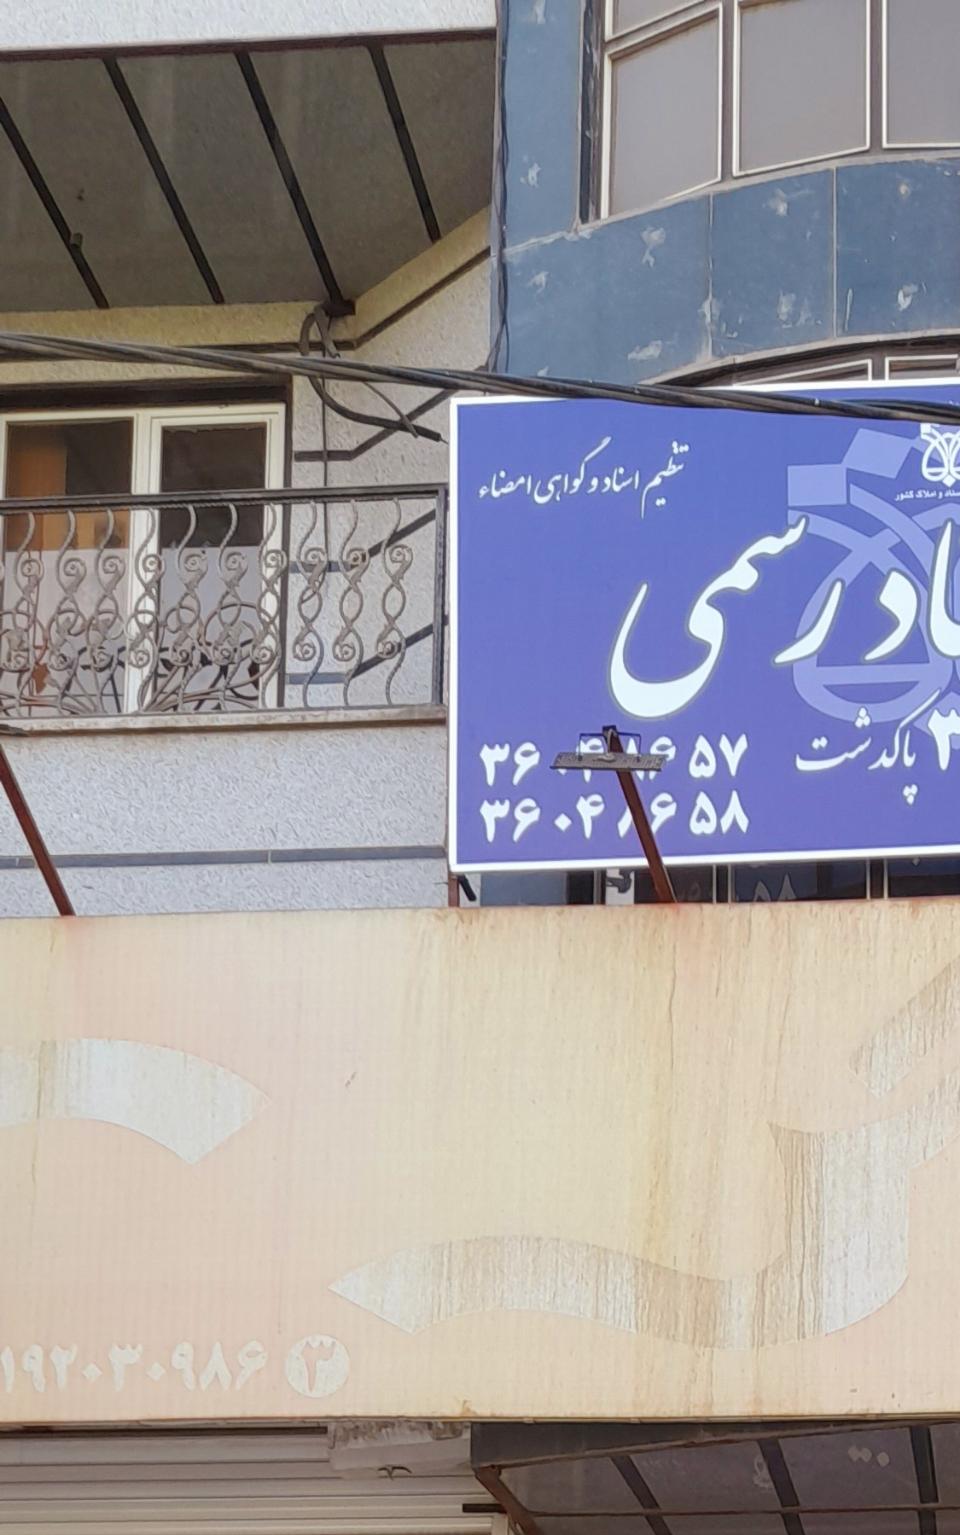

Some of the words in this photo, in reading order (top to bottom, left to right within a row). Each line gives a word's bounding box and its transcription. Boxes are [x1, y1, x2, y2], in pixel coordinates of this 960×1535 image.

[479, 471, 532, 498] امضاء
[587, 476, 599, 494] و
[602, 467, 640, 493] اسناد
[641, 441, 690, 519] تنظیم
[610, 517, 842, 719] رسمی
[796, 689, 941, 805] پاکدشت
